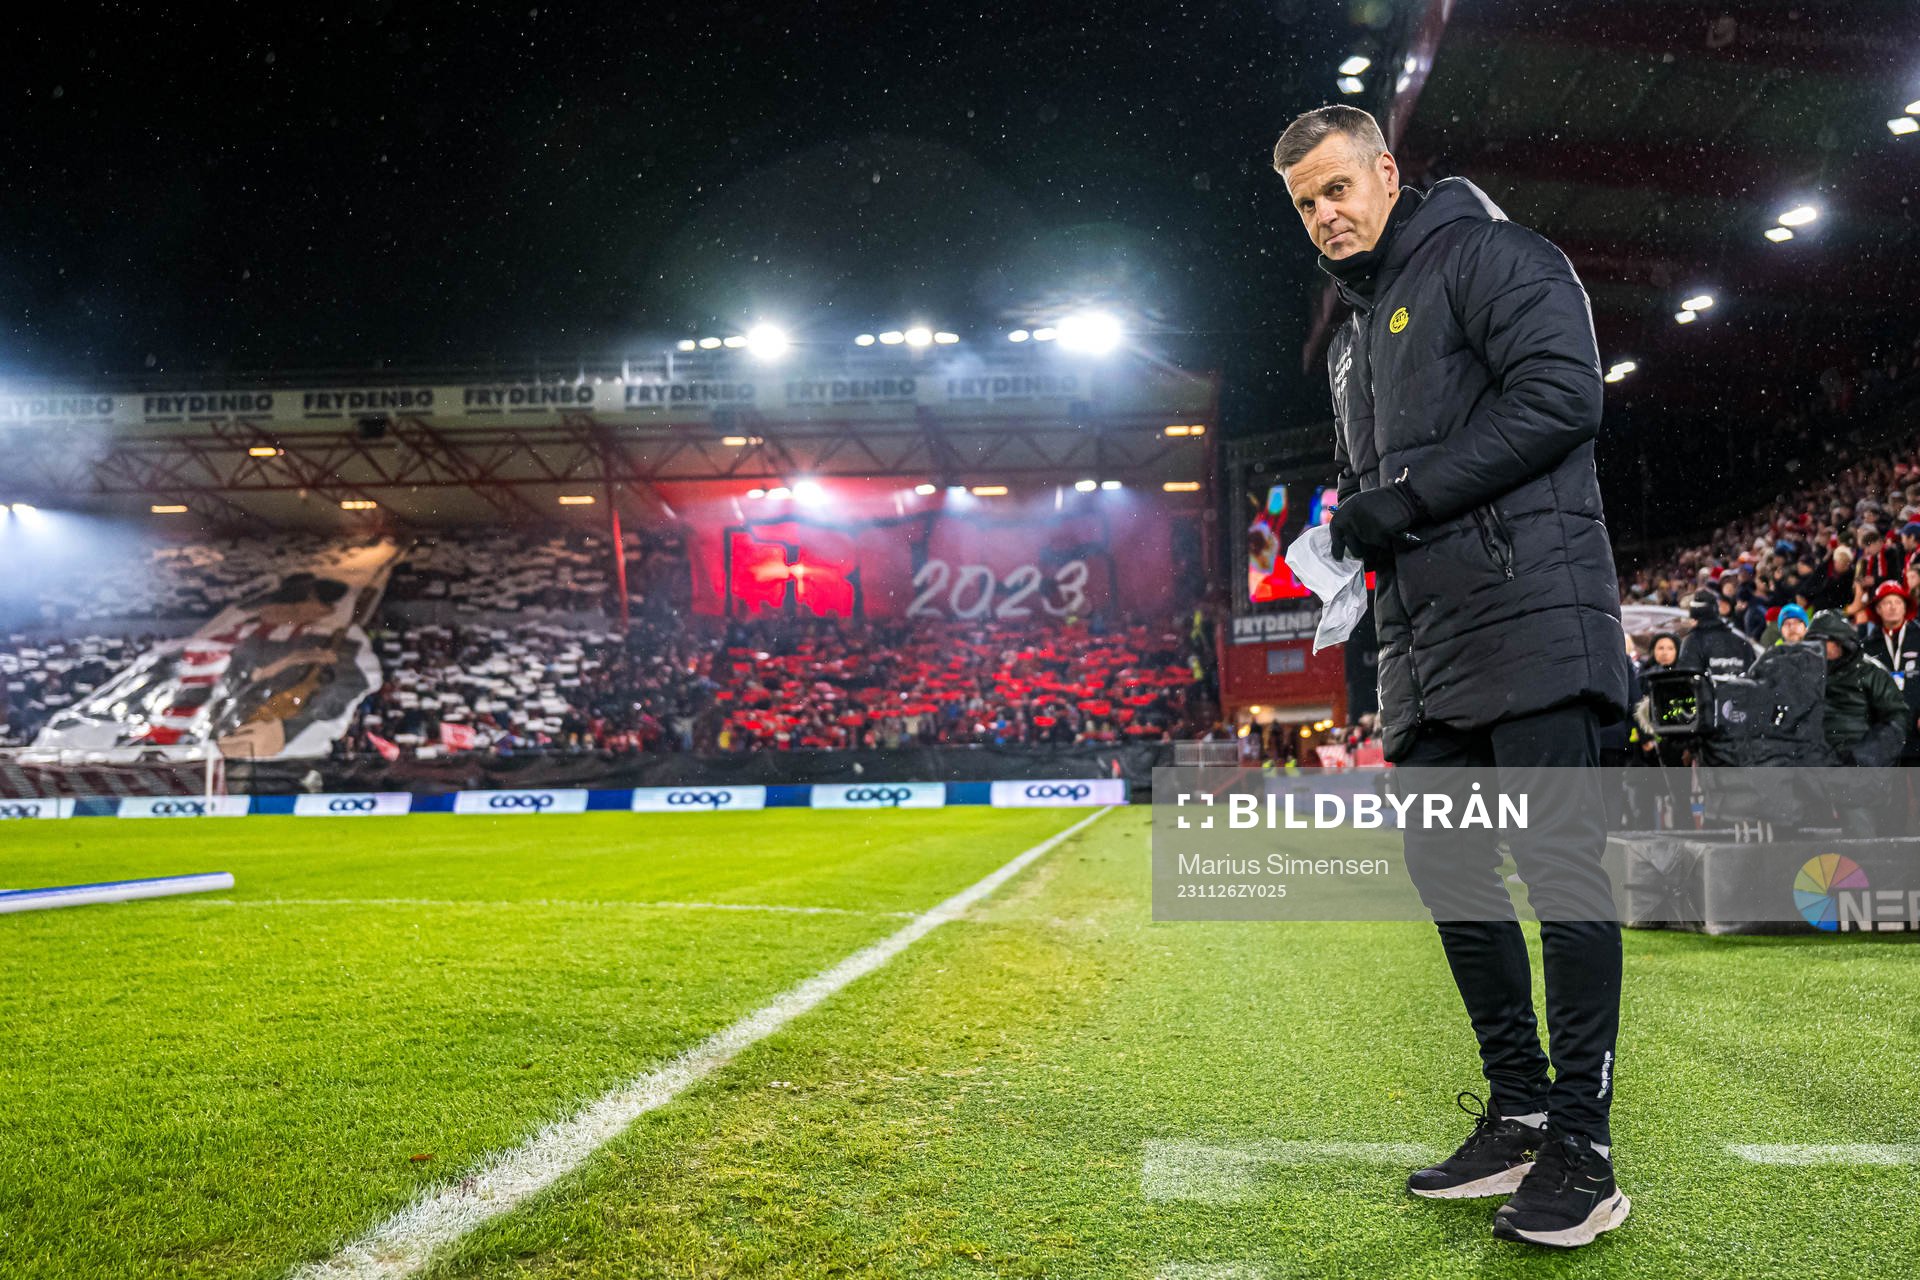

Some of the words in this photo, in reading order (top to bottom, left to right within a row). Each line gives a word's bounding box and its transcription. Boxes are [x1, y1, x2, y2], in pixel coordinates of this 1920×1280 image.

[906, 560, 1089, 619] 2023
[667, 791, 731, 810] coop
[845, 785, 911, 806] coop
[1026, 784, 1090, 801] coop
[489, 794, 554, 814] coop
